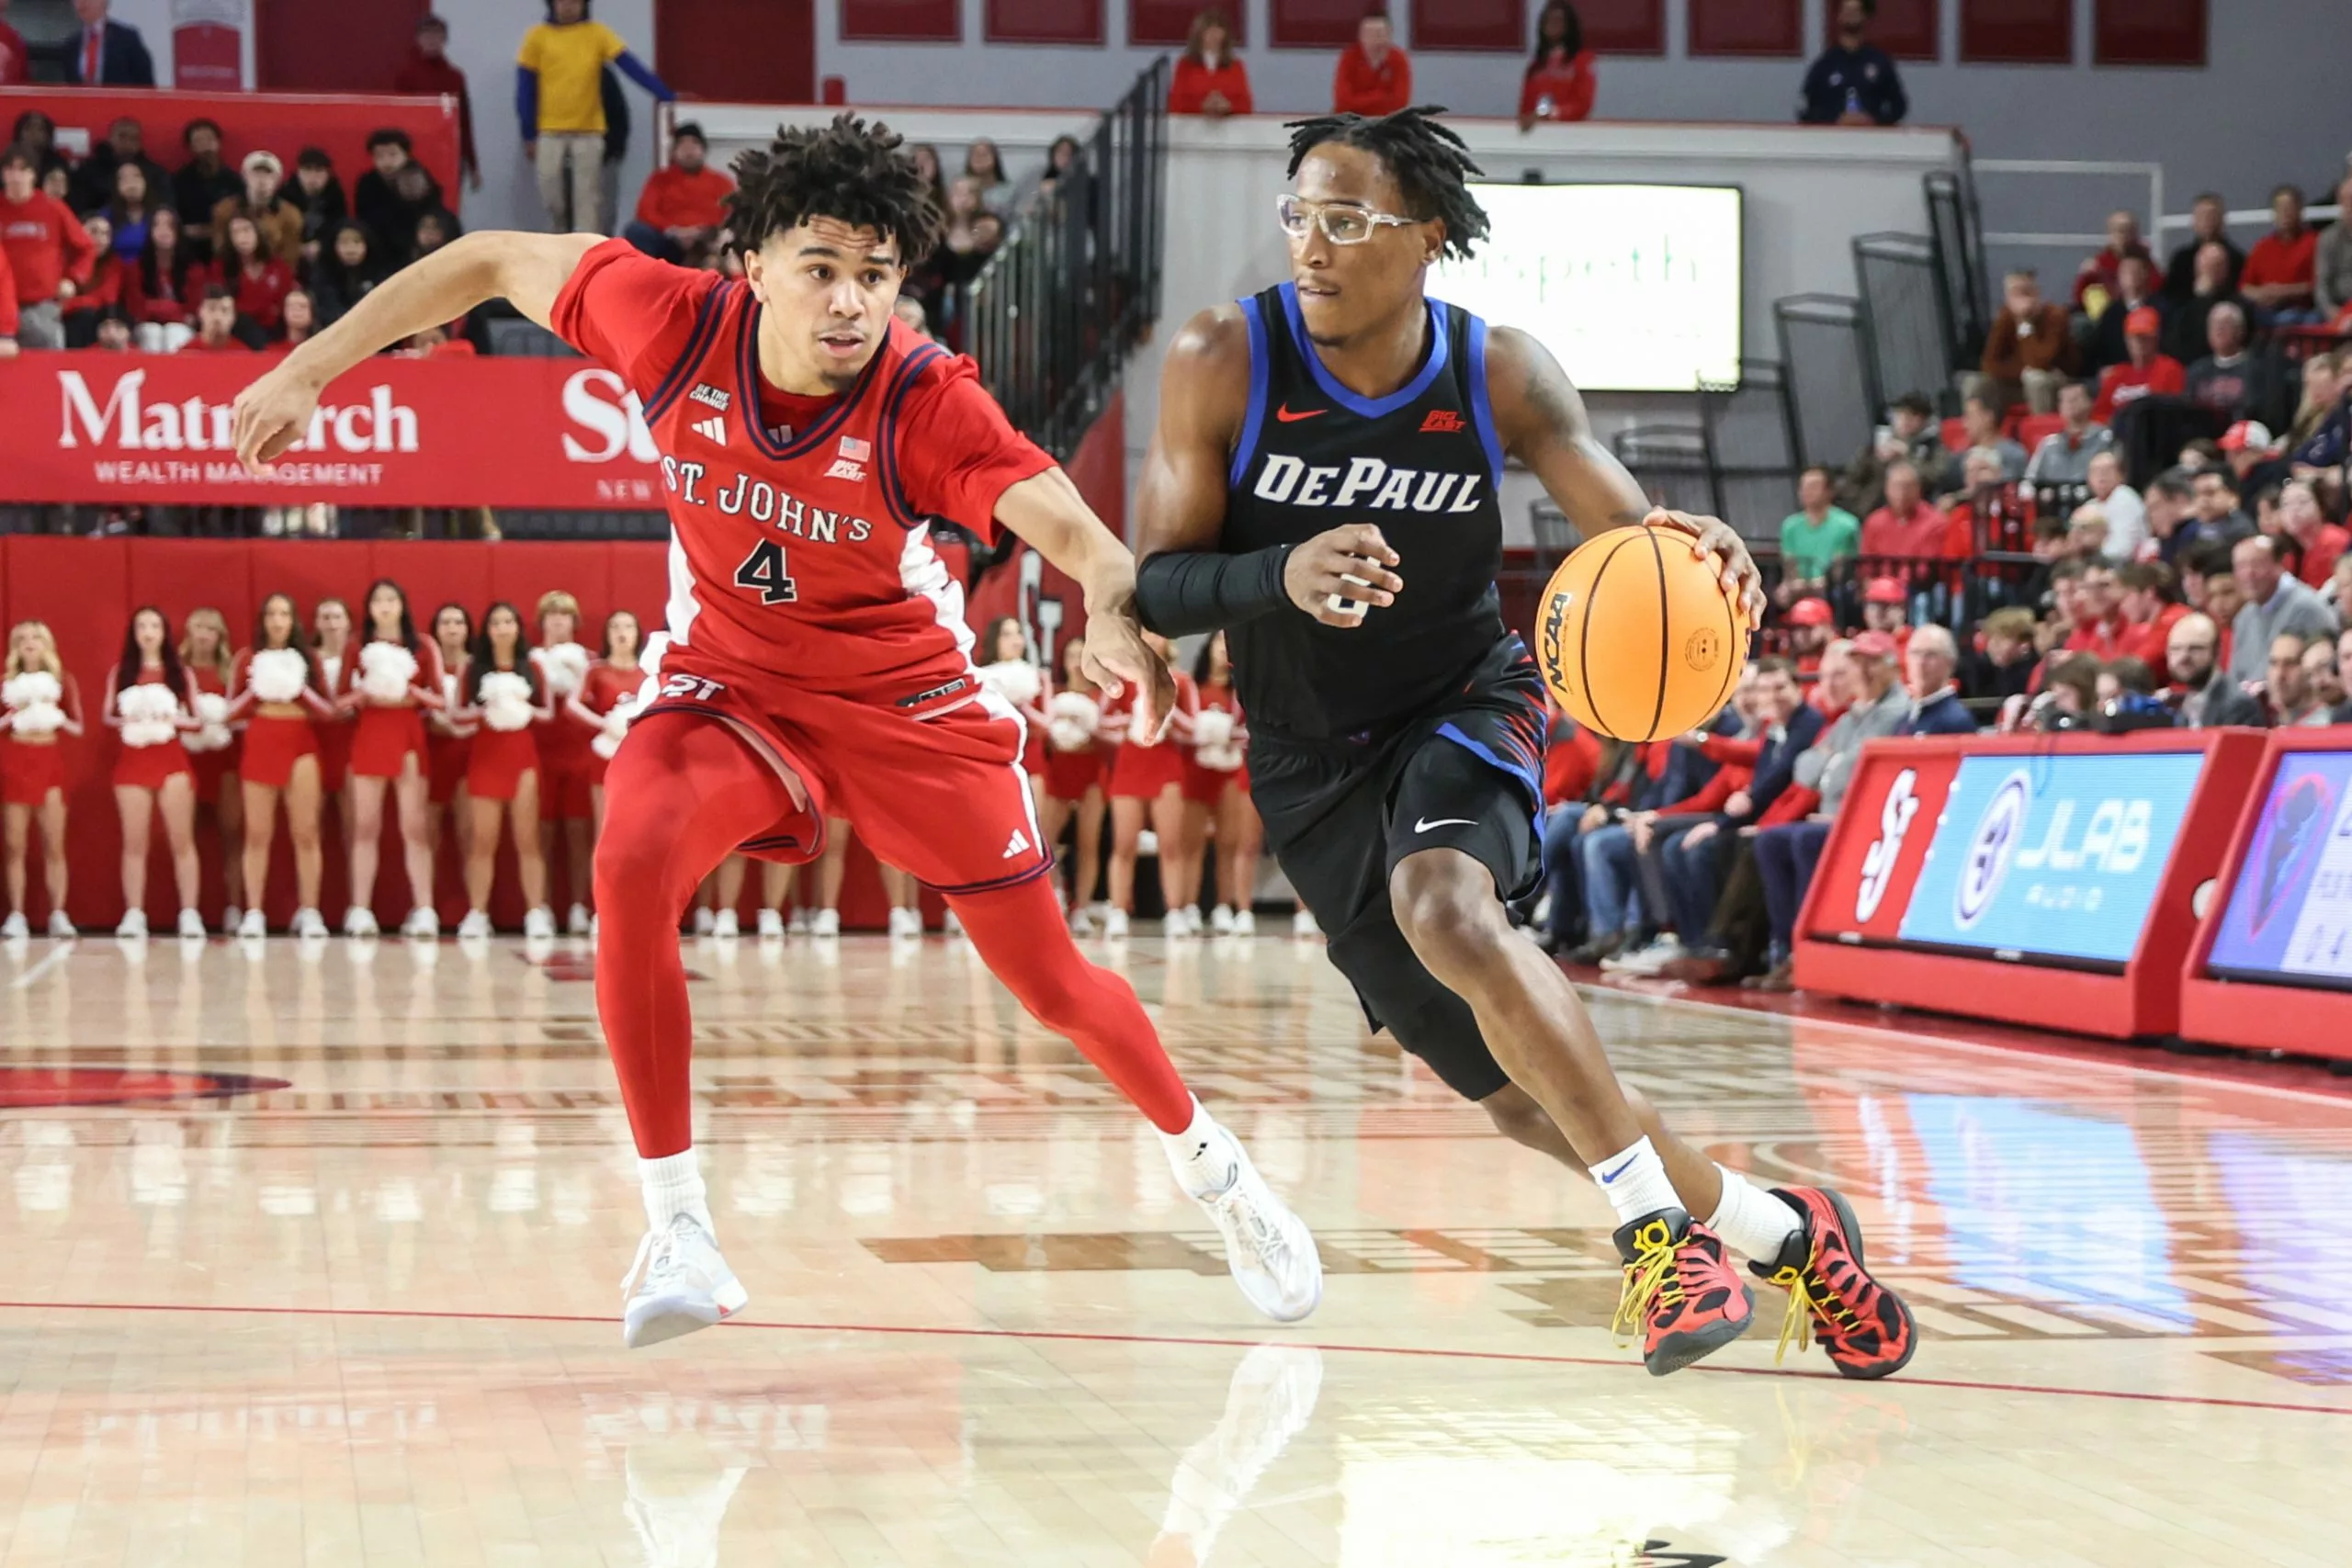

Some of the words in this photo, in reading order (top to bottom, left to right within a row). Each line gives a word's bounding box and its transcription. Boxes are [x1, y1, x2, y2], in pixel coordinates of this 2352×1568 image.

[57, 368, 420, 454] Matrrch
[95, 461, 199, 485] WEALTH
[205, 461, 384, 486] MAAGEMENT
[597, 479, 651, 502] NEW
[662, 456, 706, 505] ST.
[718, 473, 872, 543] JOHN'S
[734, 536, 797, 605] 4
[1544, 593, 1568, 694] NCAA
[2016, 797, 2153, 874] JLAB
